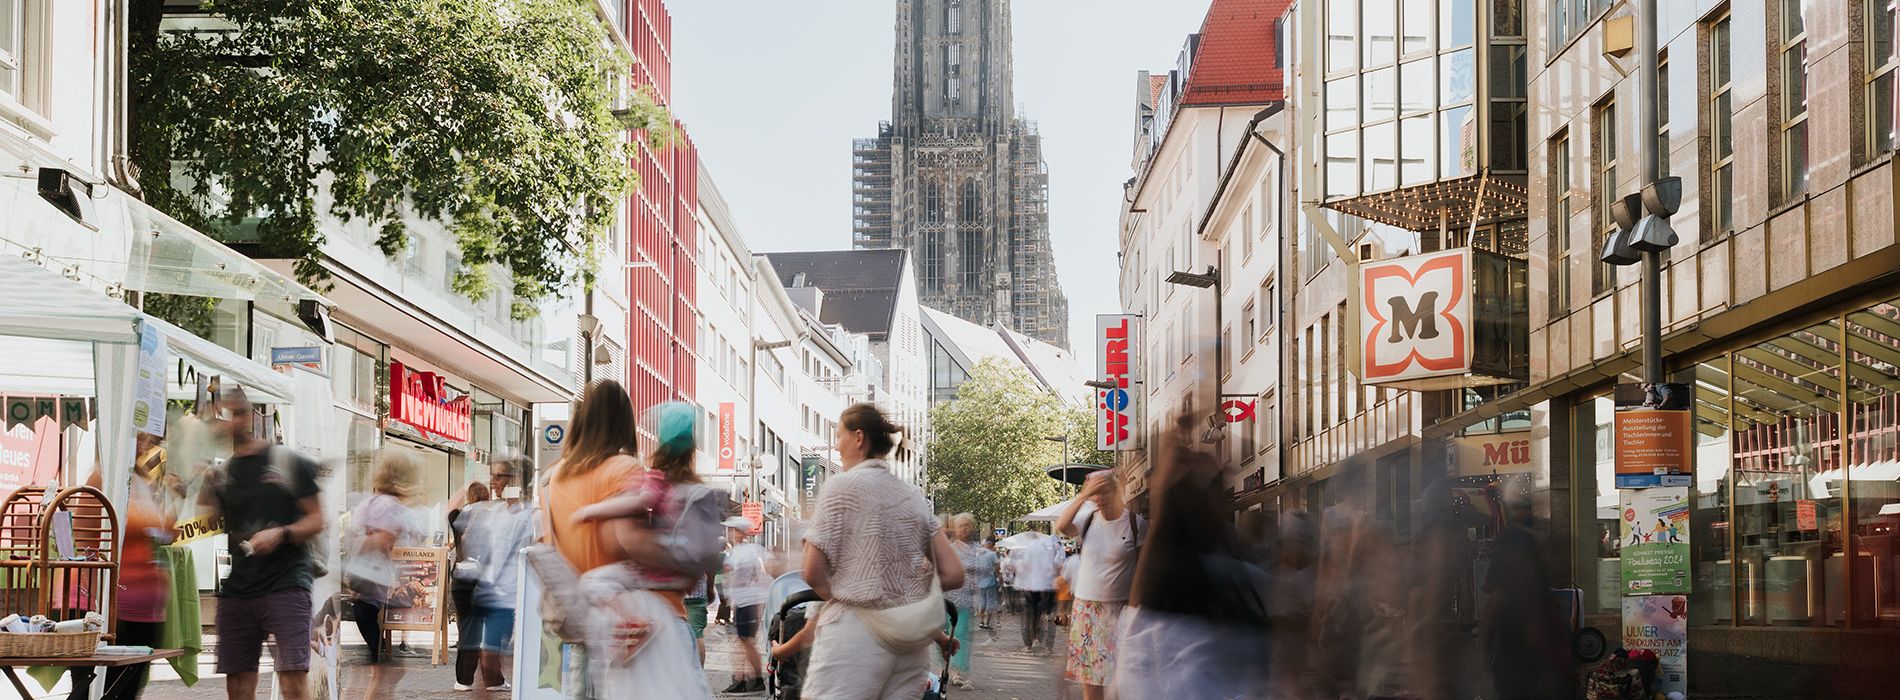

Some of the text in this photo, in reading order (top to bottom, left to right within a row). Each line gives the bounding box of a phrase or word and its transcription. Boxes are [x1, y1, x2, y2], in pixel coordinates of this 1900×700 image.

[1387, 291, 1439, 343] M
[1100, 318, 1128, 446] WÖHRL
[723, 412, 731, 446] vodafone
[1483, 440, 1531, 466] Mü
[1663, 555, 1683, 565] 2024
[1626, 625, 1658, 637] ULMER
[1626, 638, 1682, 647] SANDKUNST AM
